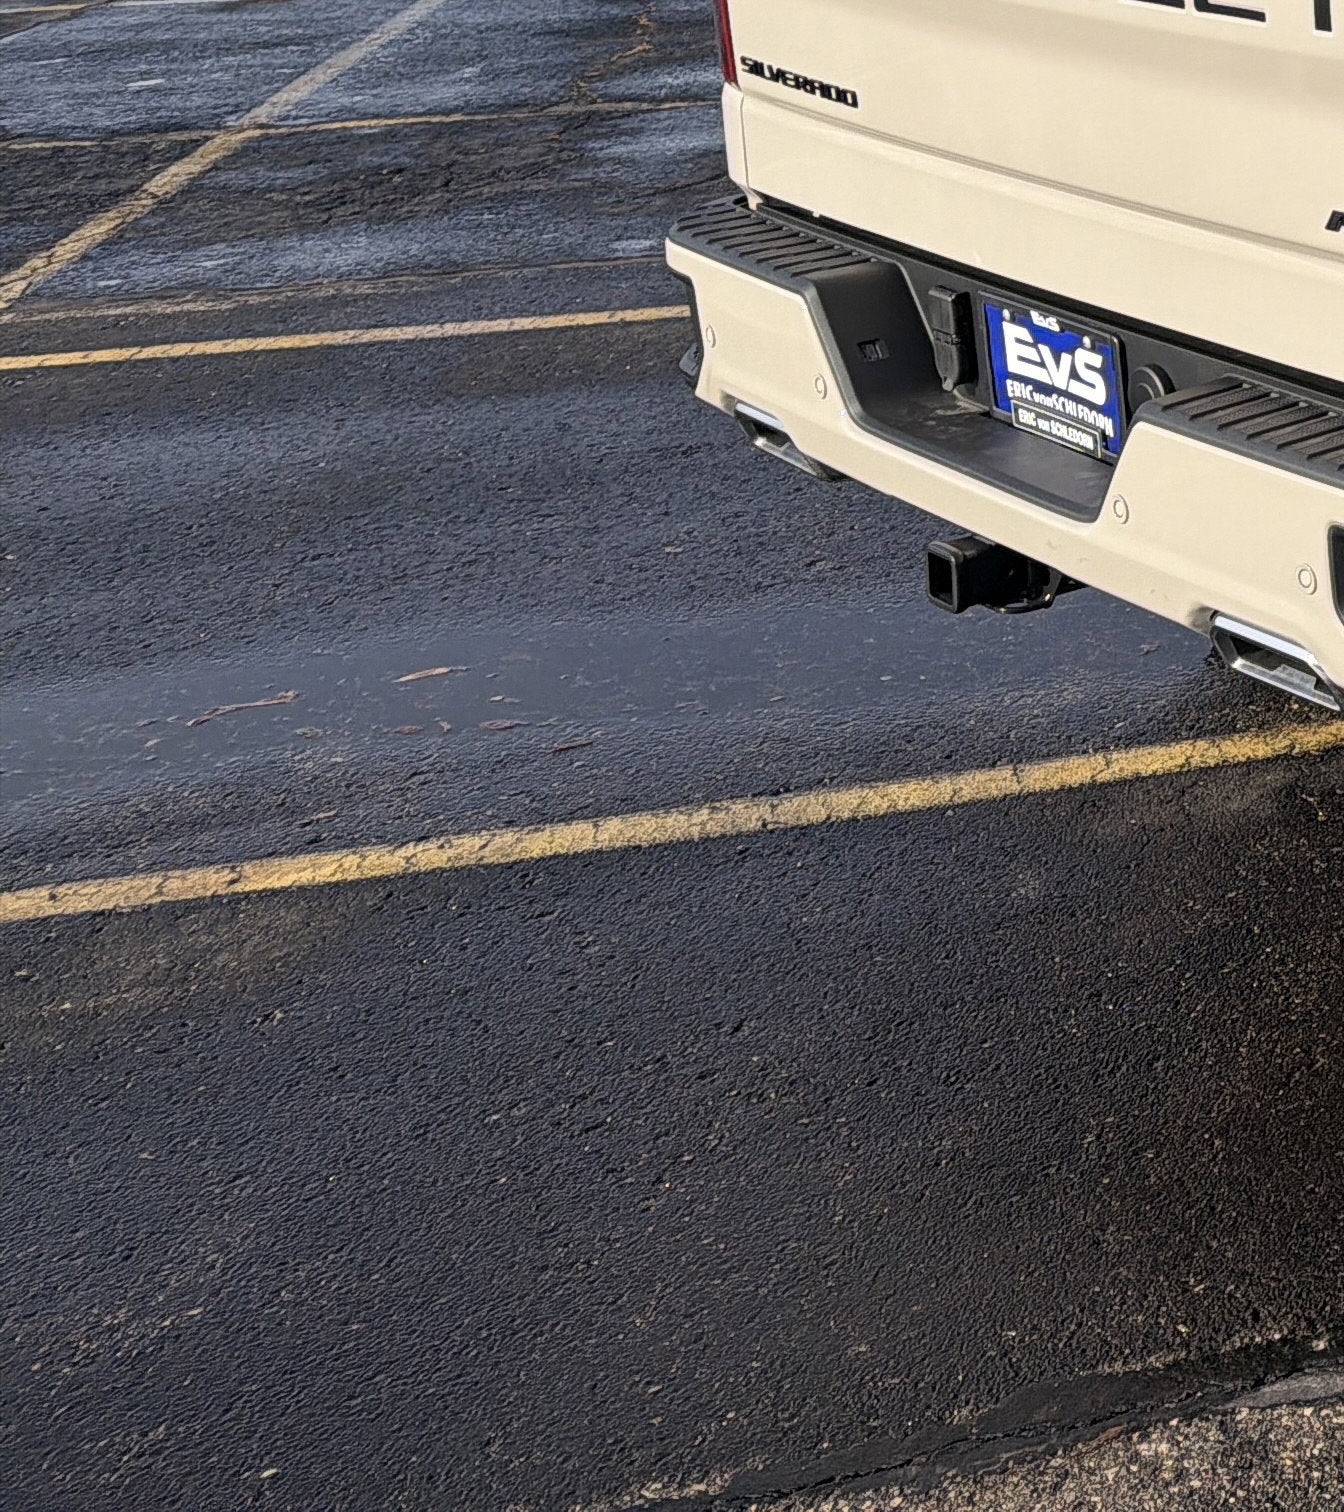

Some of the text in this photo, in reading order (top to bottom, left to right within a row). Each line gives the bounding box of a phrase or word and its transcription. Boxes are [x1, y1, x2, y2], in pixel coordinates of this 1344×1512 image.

[739, 55, 859, 109] SILVERADO
[1006, 379, 1034, 402] ERIC
[1017, 408, 1037, 427] ERIC
[1050, 420, 1094, 451] SCHLEDORN
